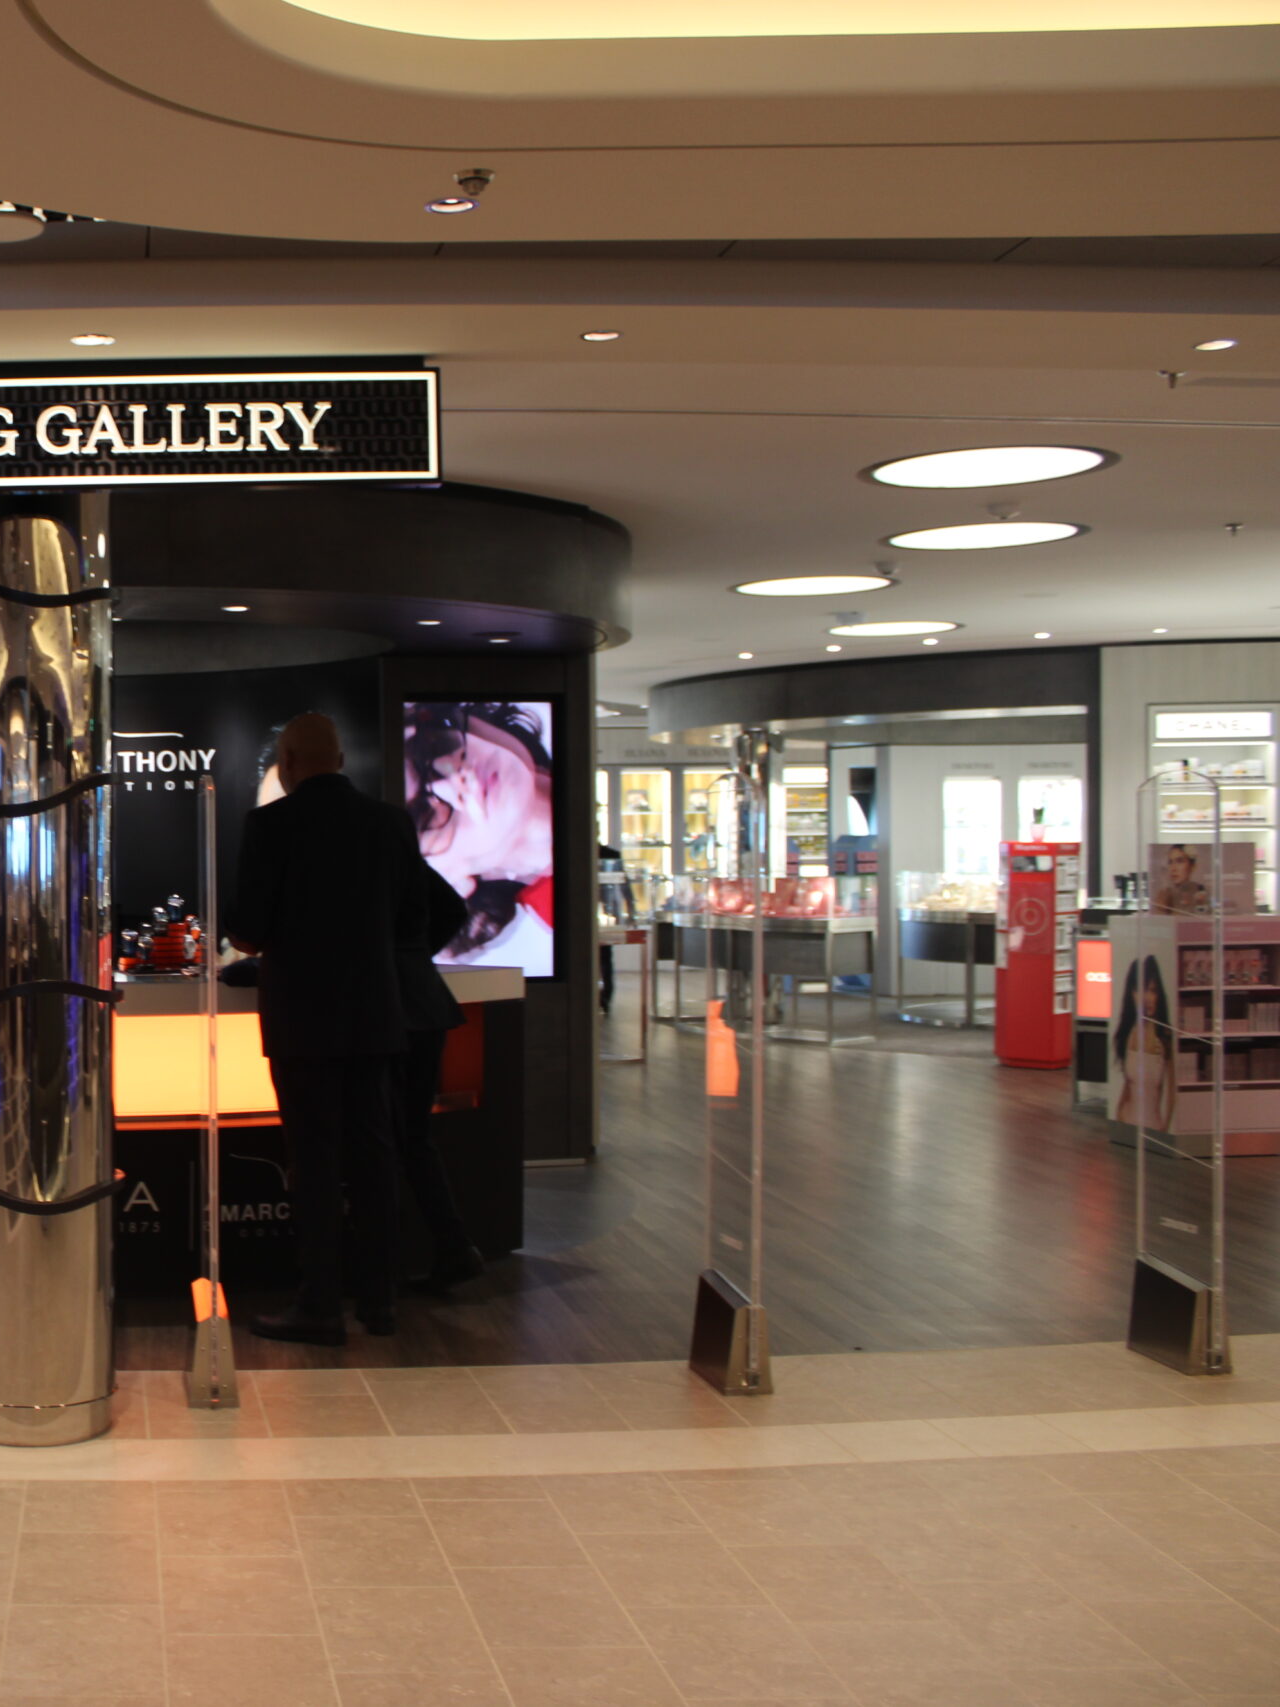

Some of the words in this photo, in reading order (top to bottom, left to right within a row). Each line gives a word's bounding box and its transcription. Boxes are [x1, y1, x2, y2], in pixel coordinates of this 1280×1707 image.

[35, 401, 332, 455] GALLERY
[117, 749, 216, 773] THONY
[220, 1202, 292, 1222] MARC
